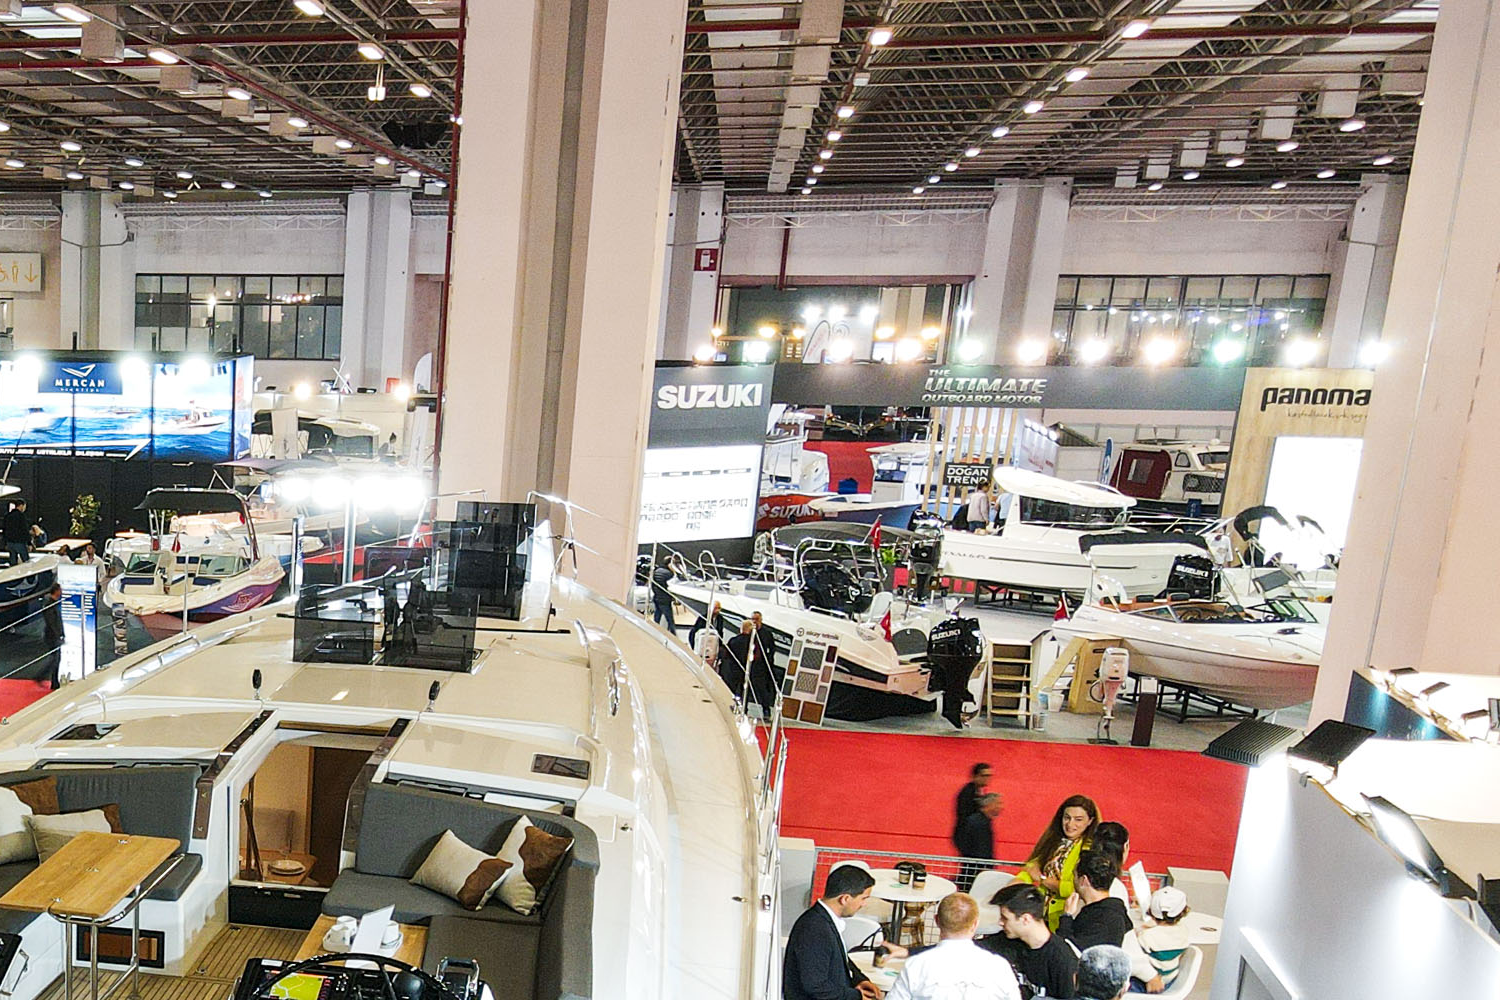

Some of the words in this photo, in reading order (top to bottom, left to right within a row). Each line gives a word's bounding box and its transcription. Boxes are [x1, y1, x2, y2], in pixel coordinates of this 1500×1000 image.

[929, 369, 951, 377] THE
[54, 378, 105, 388] MERCAN
[924, 377, 1048, 394] ULTIMATE
[657, 383, 763, 409] SUZUKI
[921, 394, 993, 403] OUTBOARD
[994, 395, 1043, 404] MOTOR
[1176, 564, 1209, 578] SUZUKI
[931, 628, 961, 641] SUZUKI
